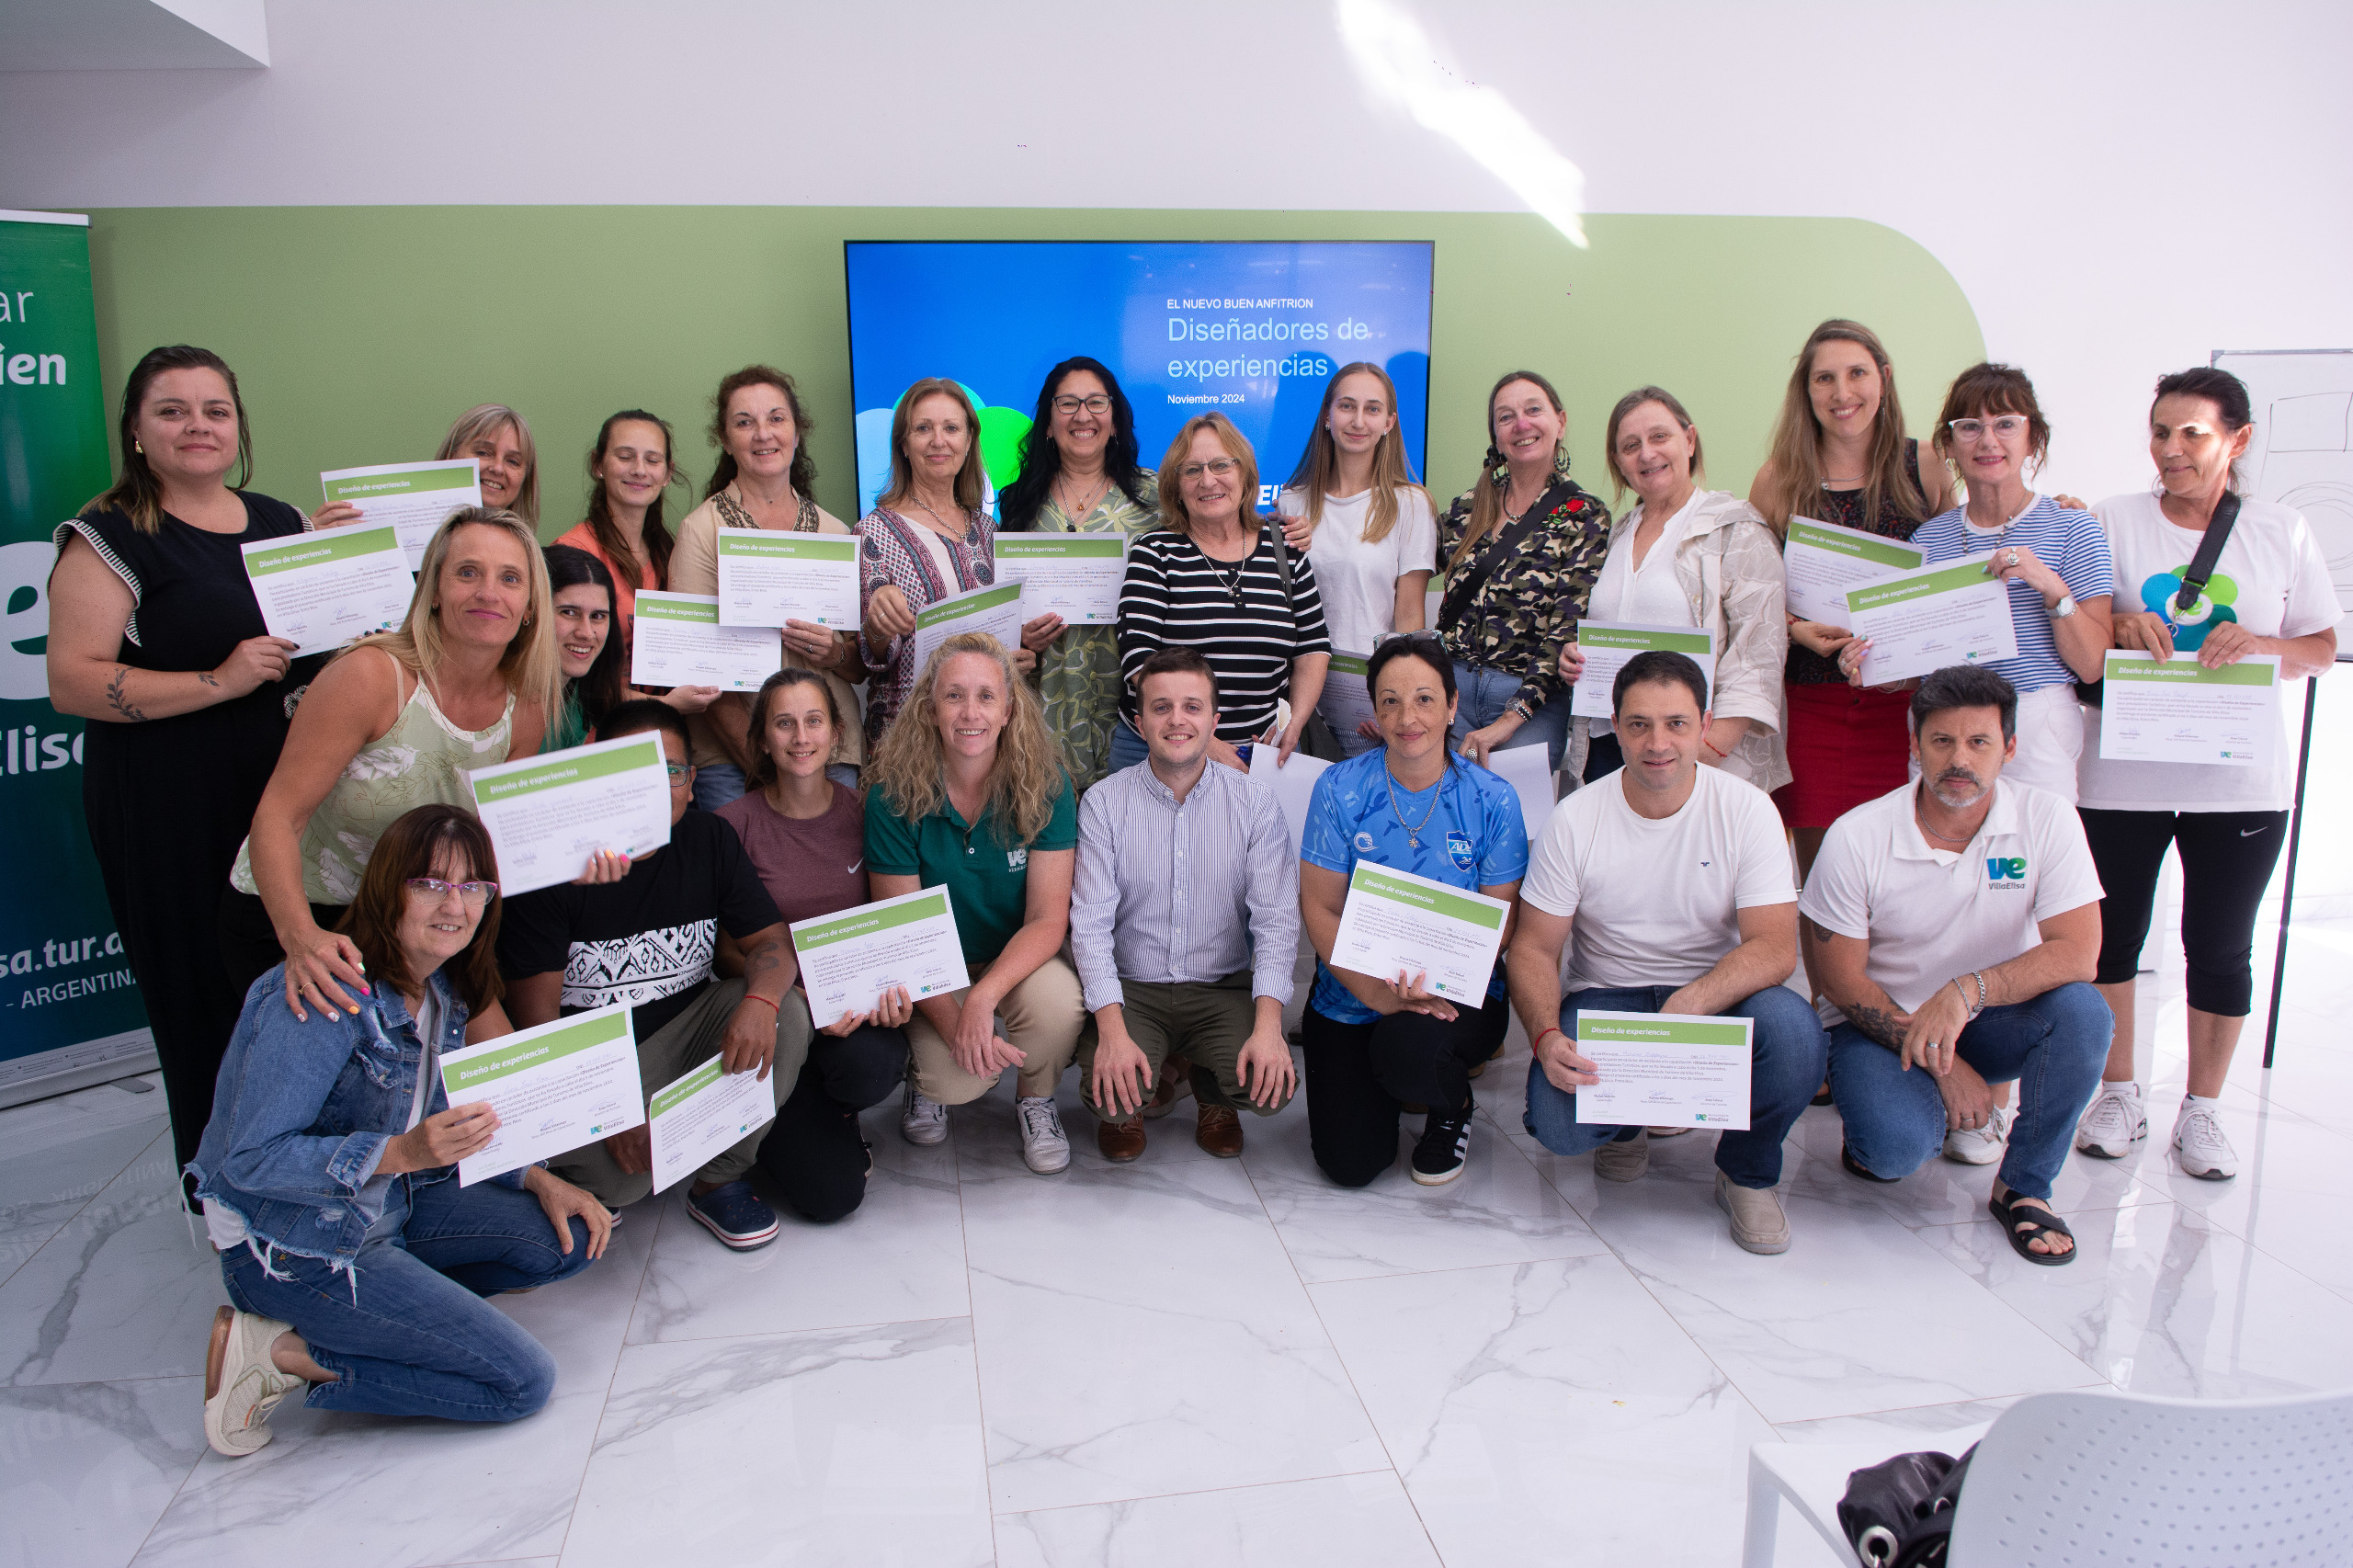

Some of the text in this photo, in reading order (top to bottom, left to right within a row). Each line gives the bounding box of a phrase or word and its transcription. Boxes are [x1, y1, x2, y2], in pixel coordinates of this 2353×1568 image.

[1167, 299, 1313, 309] EL NUEVO BUEN ANFITRION
[1168, 316, 1369, 341] Diseñadores de
[1167, 354, 1328, 382] experiencias
[1167, 393, 1245, 404] Noviembre 2024
[338, 485, 361, 494] Diseño
[371, 481, 411, 491] experiencias
[1799, 531, 1818, 540] Diseño
[1825, 539, 1860, 551] experiencias
[259, 558, 282, 568] Diseño
[291, 549, 332, 562] experiencias
[1859, 595, 1881, 604] Diseño
[1890, 584, 1929, 597] experiencias
[490, 768, 578, 794] Diseño de experiencias
[1364, 879, 1386, 891] Diseño
[1395, 890, 1434, 903] experiencias
[807, 932, 829, 942] Diseño
[839, 919, 879, 934] experiencias
[21, 968, 136, 1009] ARGENTIN
[460, 1047, 550, 1080] Diseño de experiencias
